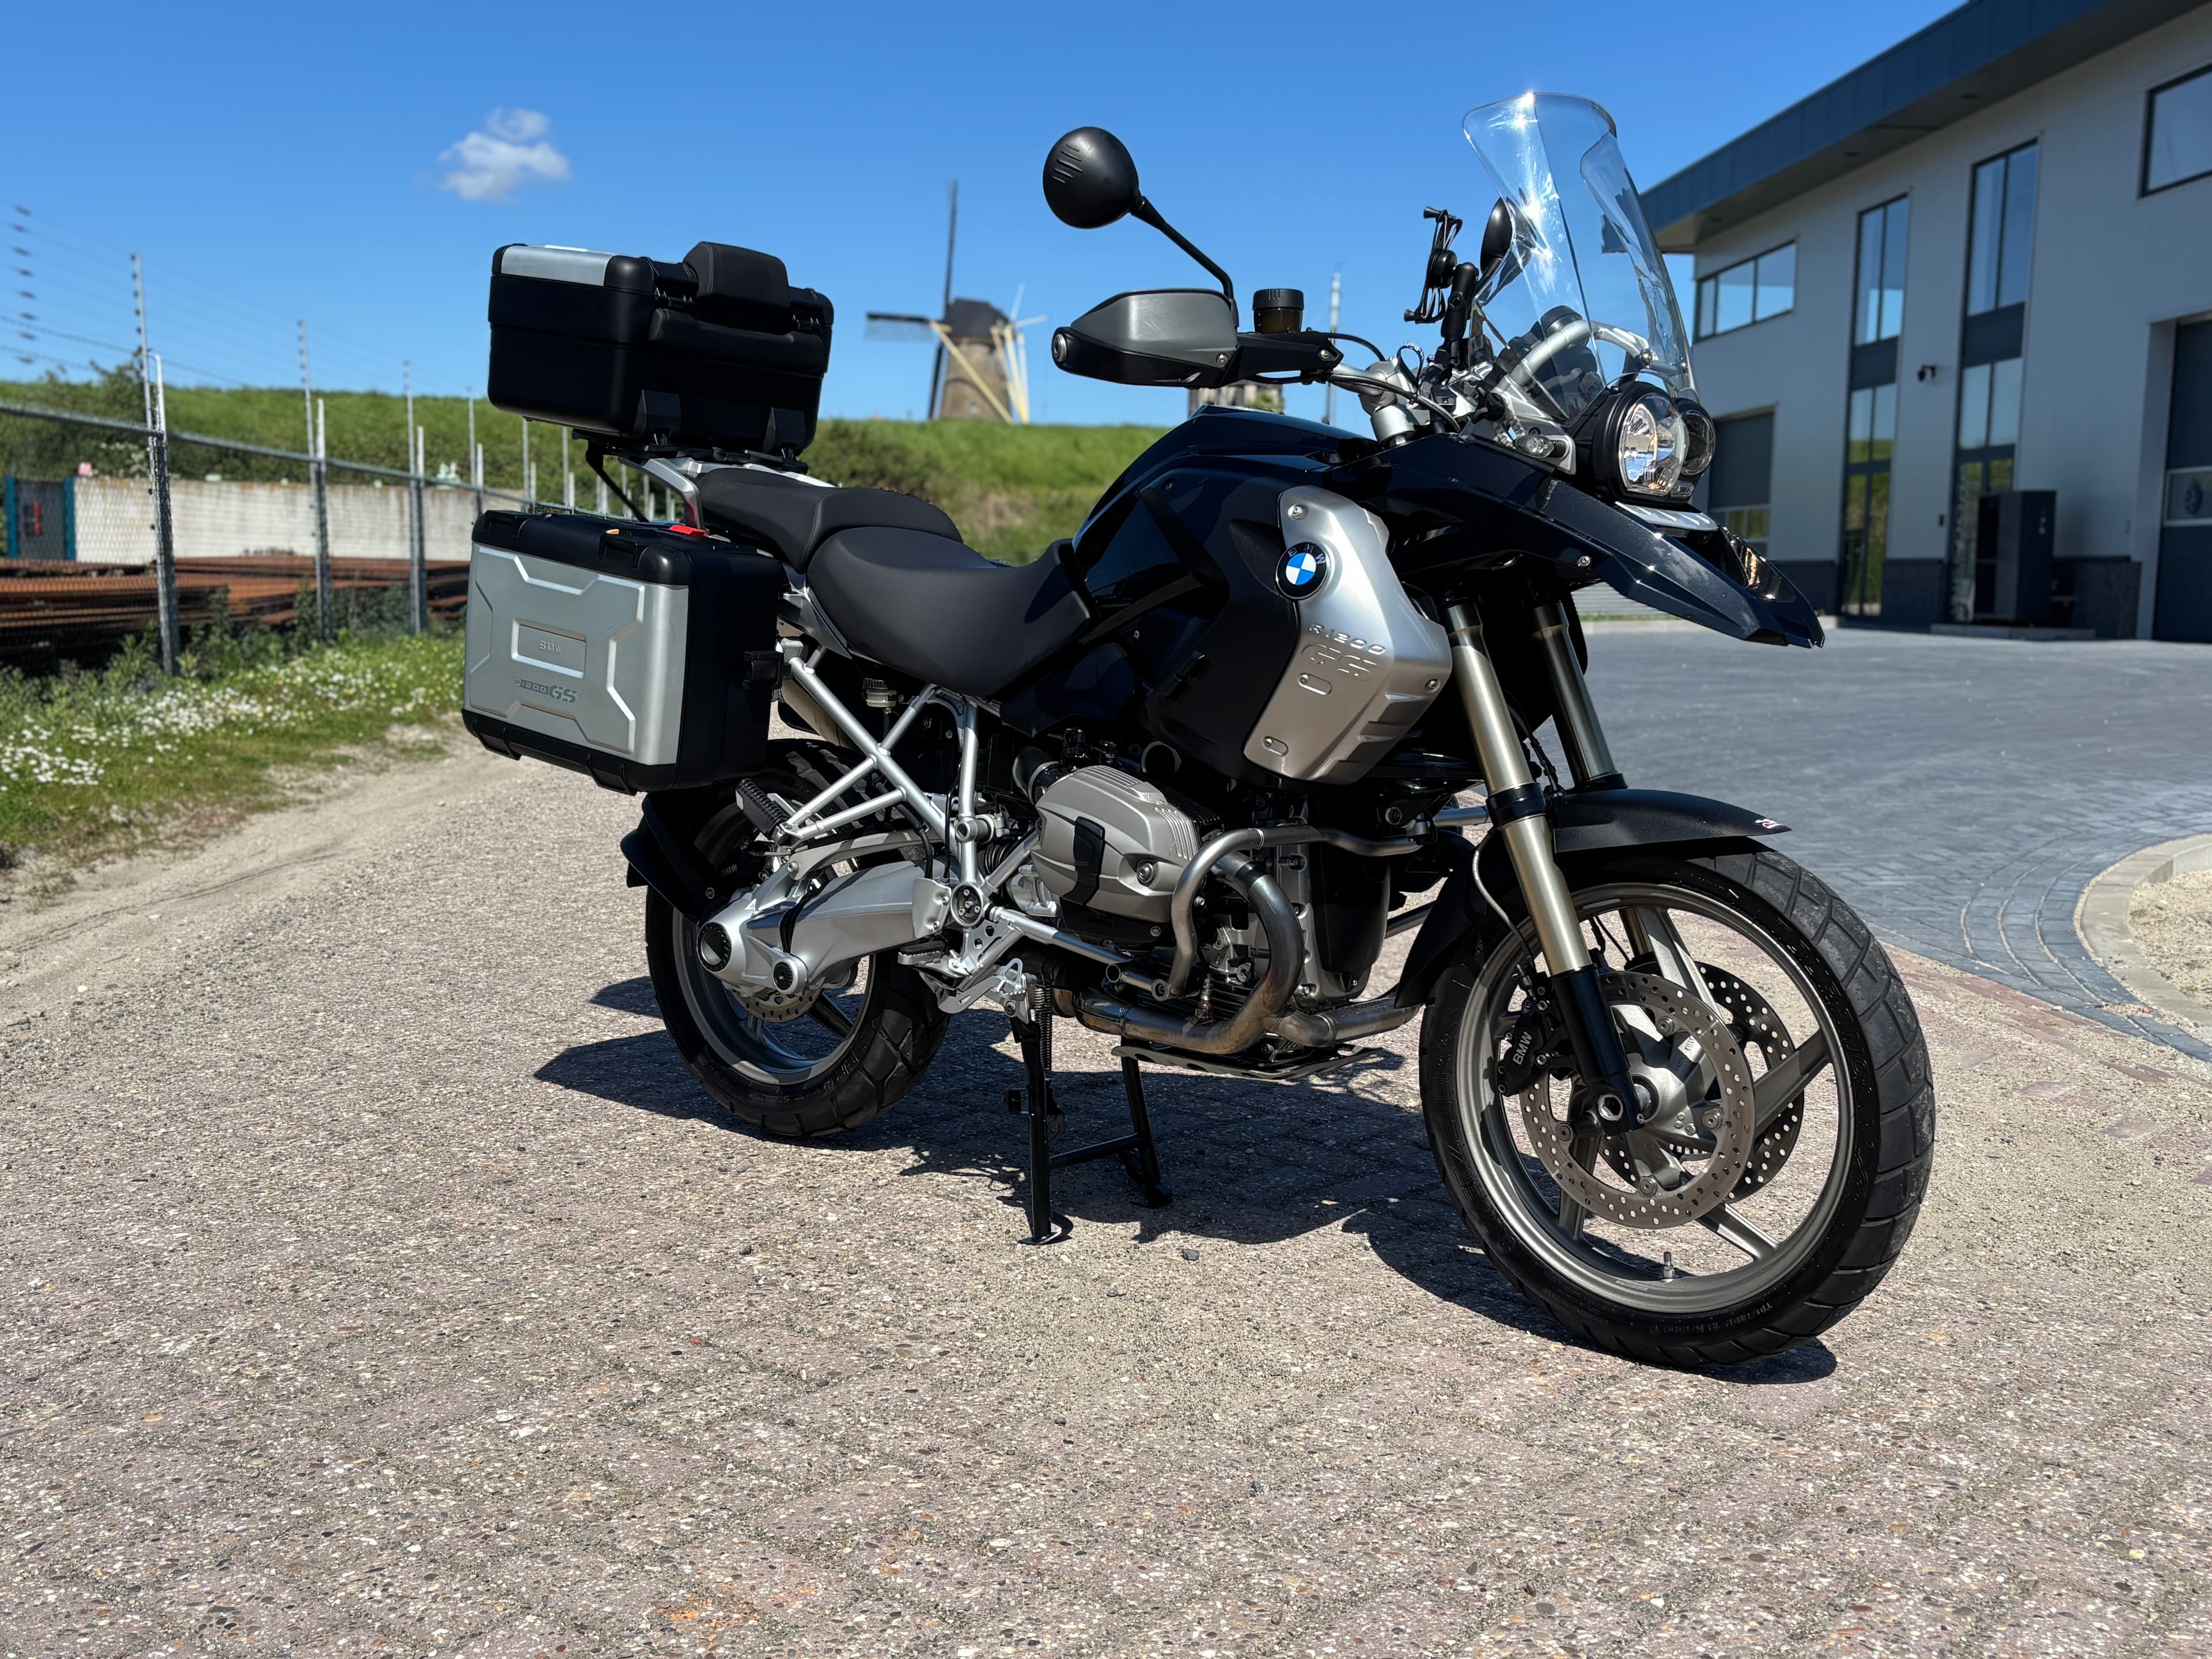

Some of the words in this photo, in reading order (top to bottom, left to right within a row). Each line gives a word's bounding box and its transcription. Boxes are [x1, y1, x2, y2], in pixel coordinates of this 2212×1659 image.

[1287, 544, 1327, 565] BMW
[539, 640, 563, 654] BMW
[1309, 623, 1386, 656] R1200
[1512, 1031, 1532, 1065] BMW
